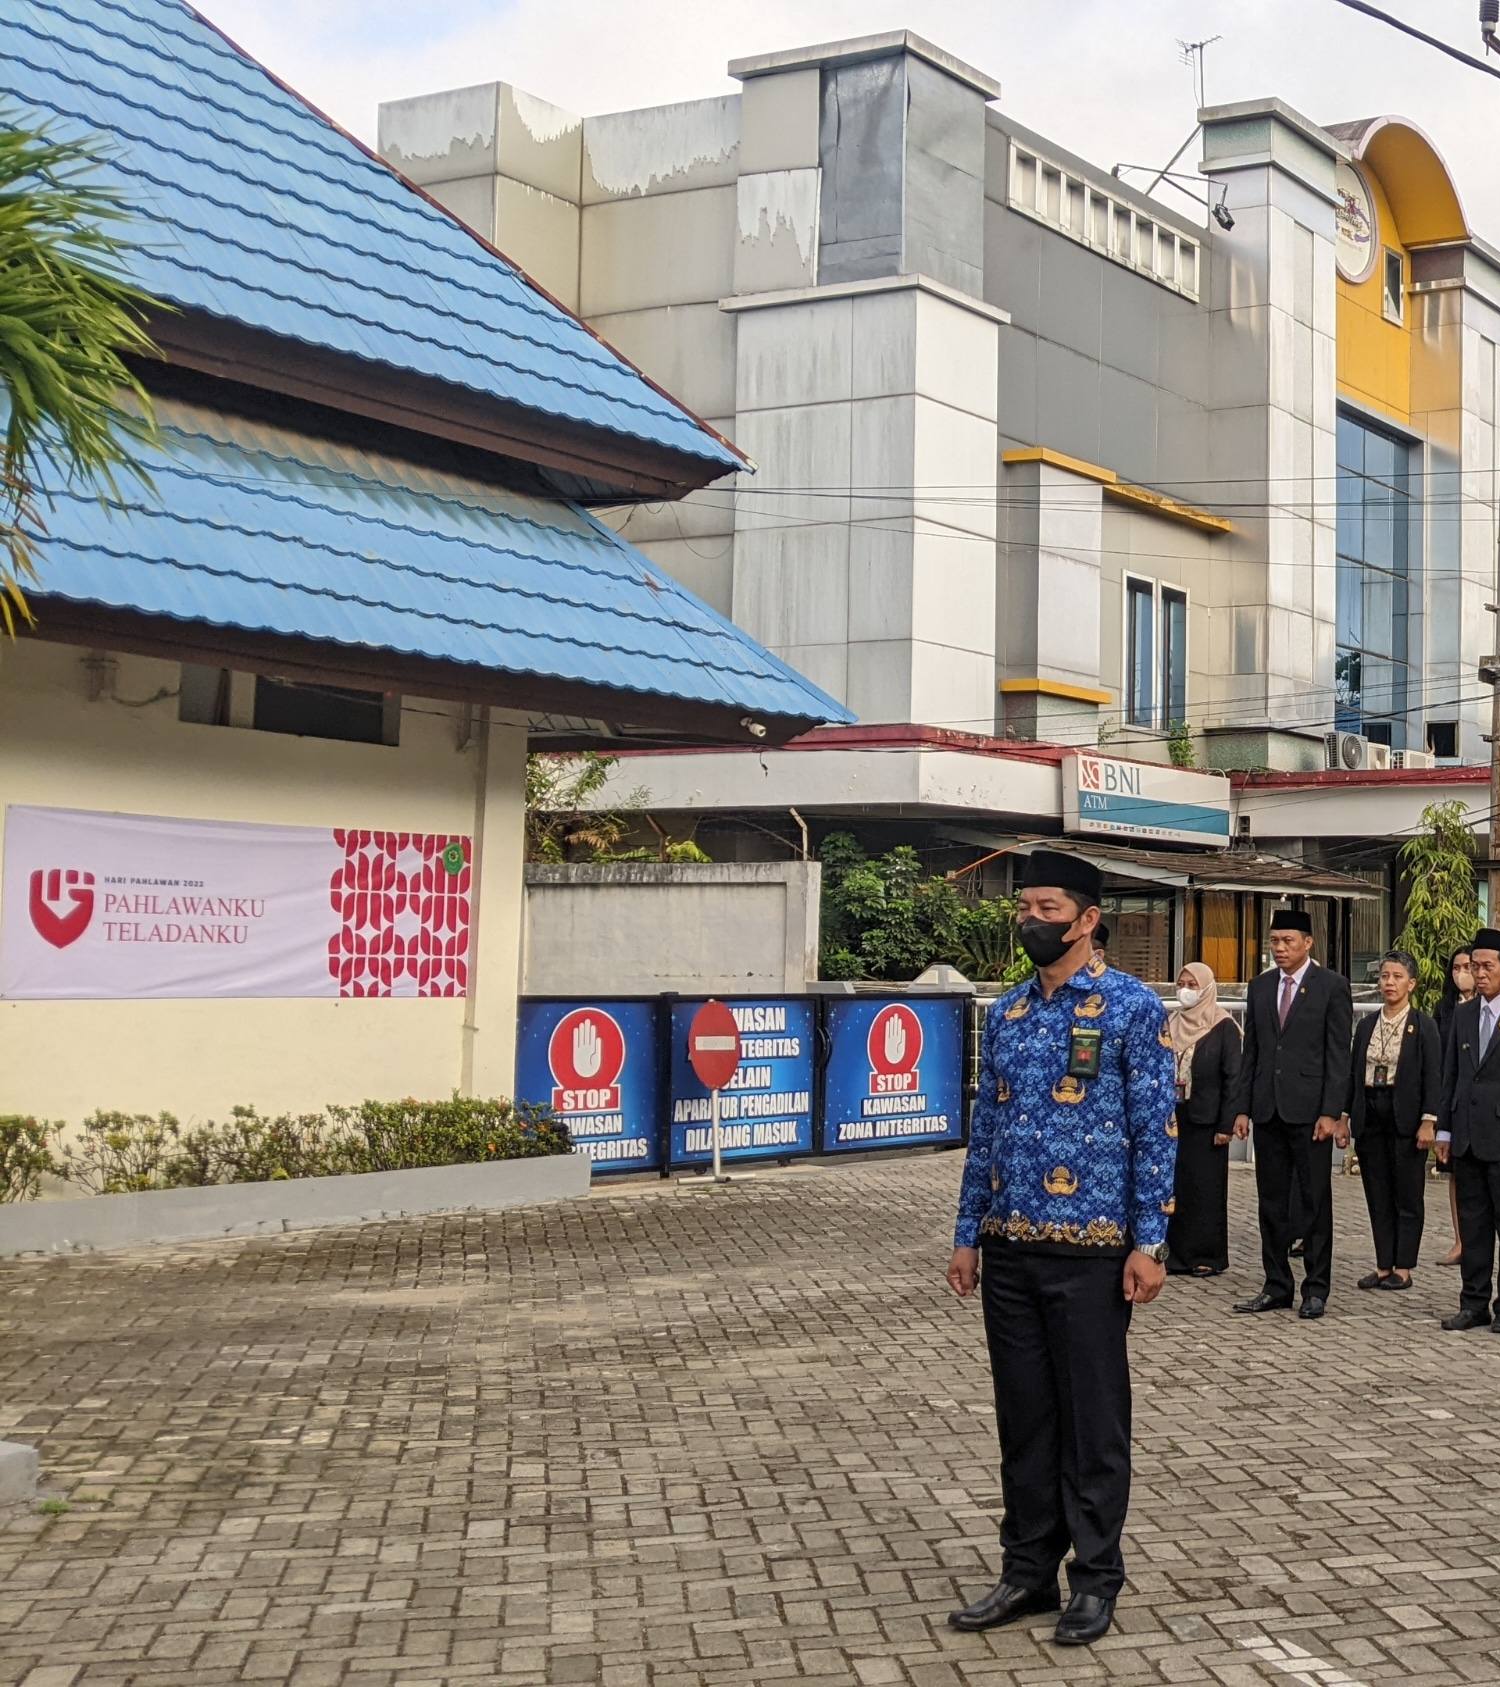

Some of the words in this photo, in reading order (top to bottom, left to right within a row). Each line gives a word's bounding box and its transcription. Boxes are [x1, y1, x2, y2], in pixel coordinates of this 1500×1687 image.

[1104, 763, 1141, 795] BNI
[1083, 795, 1107, 810] ATM
[104, 876, 126, 884] HARI
[130, 878, 180, 887] PAHLAWAN
[183, 880, 204, 888] 2022
[104, 893, 265, 918] PAHLAWANKU
[103, 922, 248, 944] TELADANKU
[730, 1007, 786, 1032] WASAN
[740, 1038, 800, 1058] TEGRITAS
[721, 1066, 771, 1090] ELAIN
[877, 1073, 912, 1092] STOP
[562, 1088, 611, 1110] STOP
[740, 1092, 809, 1117] PENGADILAN
[863, 1095, 926, 1116] KAWASAN
[554, 1114, 623, 1136] WASAN
[838, 1121, 873, 1140] ZONA
[875, 1115, 948, 1137] INTEGRITAS
[685, 1123, 751, 1152] DILARANG
[753, 1121, 798, 1145] MASUK
[571, 1138, 648, 1161] TEGRITAS
